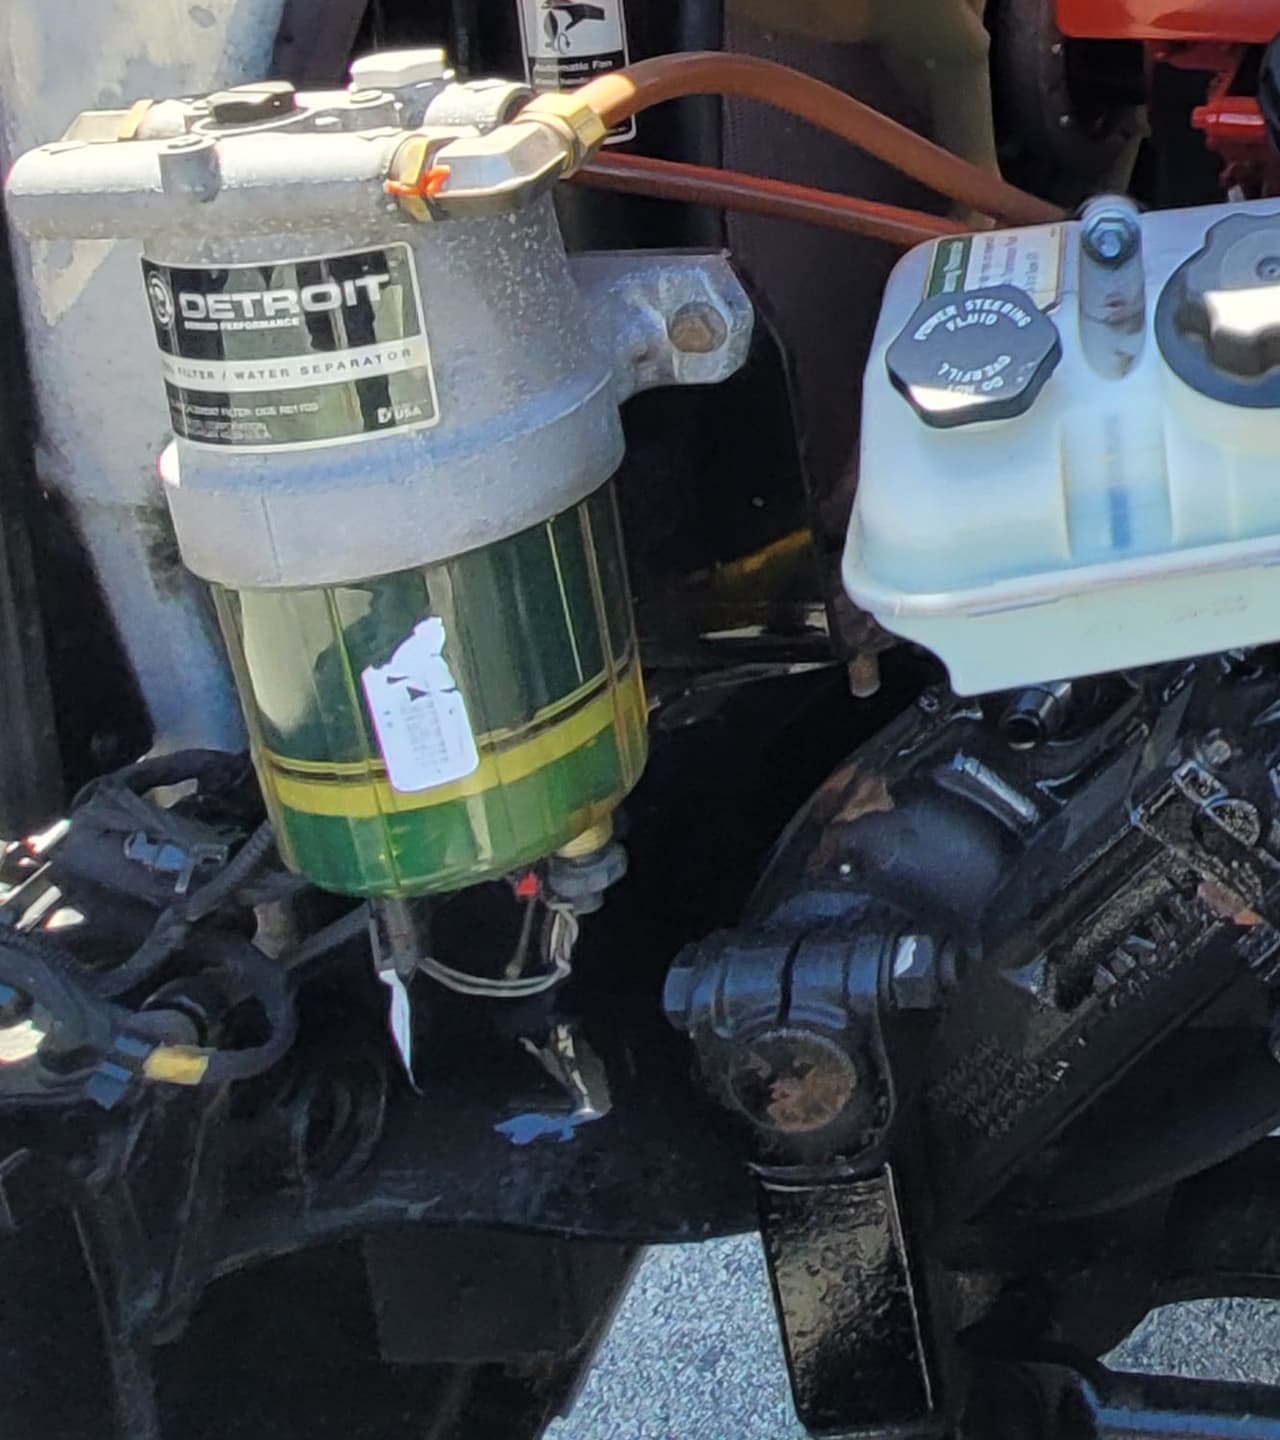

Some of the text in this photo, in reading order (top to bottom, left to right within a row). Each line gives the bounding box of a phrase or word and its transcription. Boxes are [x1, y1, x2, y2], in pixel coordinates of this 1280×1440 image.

[178, 273, 391, 320] DETROIT
[913, 298, 1032, 341] POWER STEERING
[945, 312, 998, 332] FLUID
[233, 367, 290, 382] WATER
[300, 348, 412, 377] SEPARATOR
